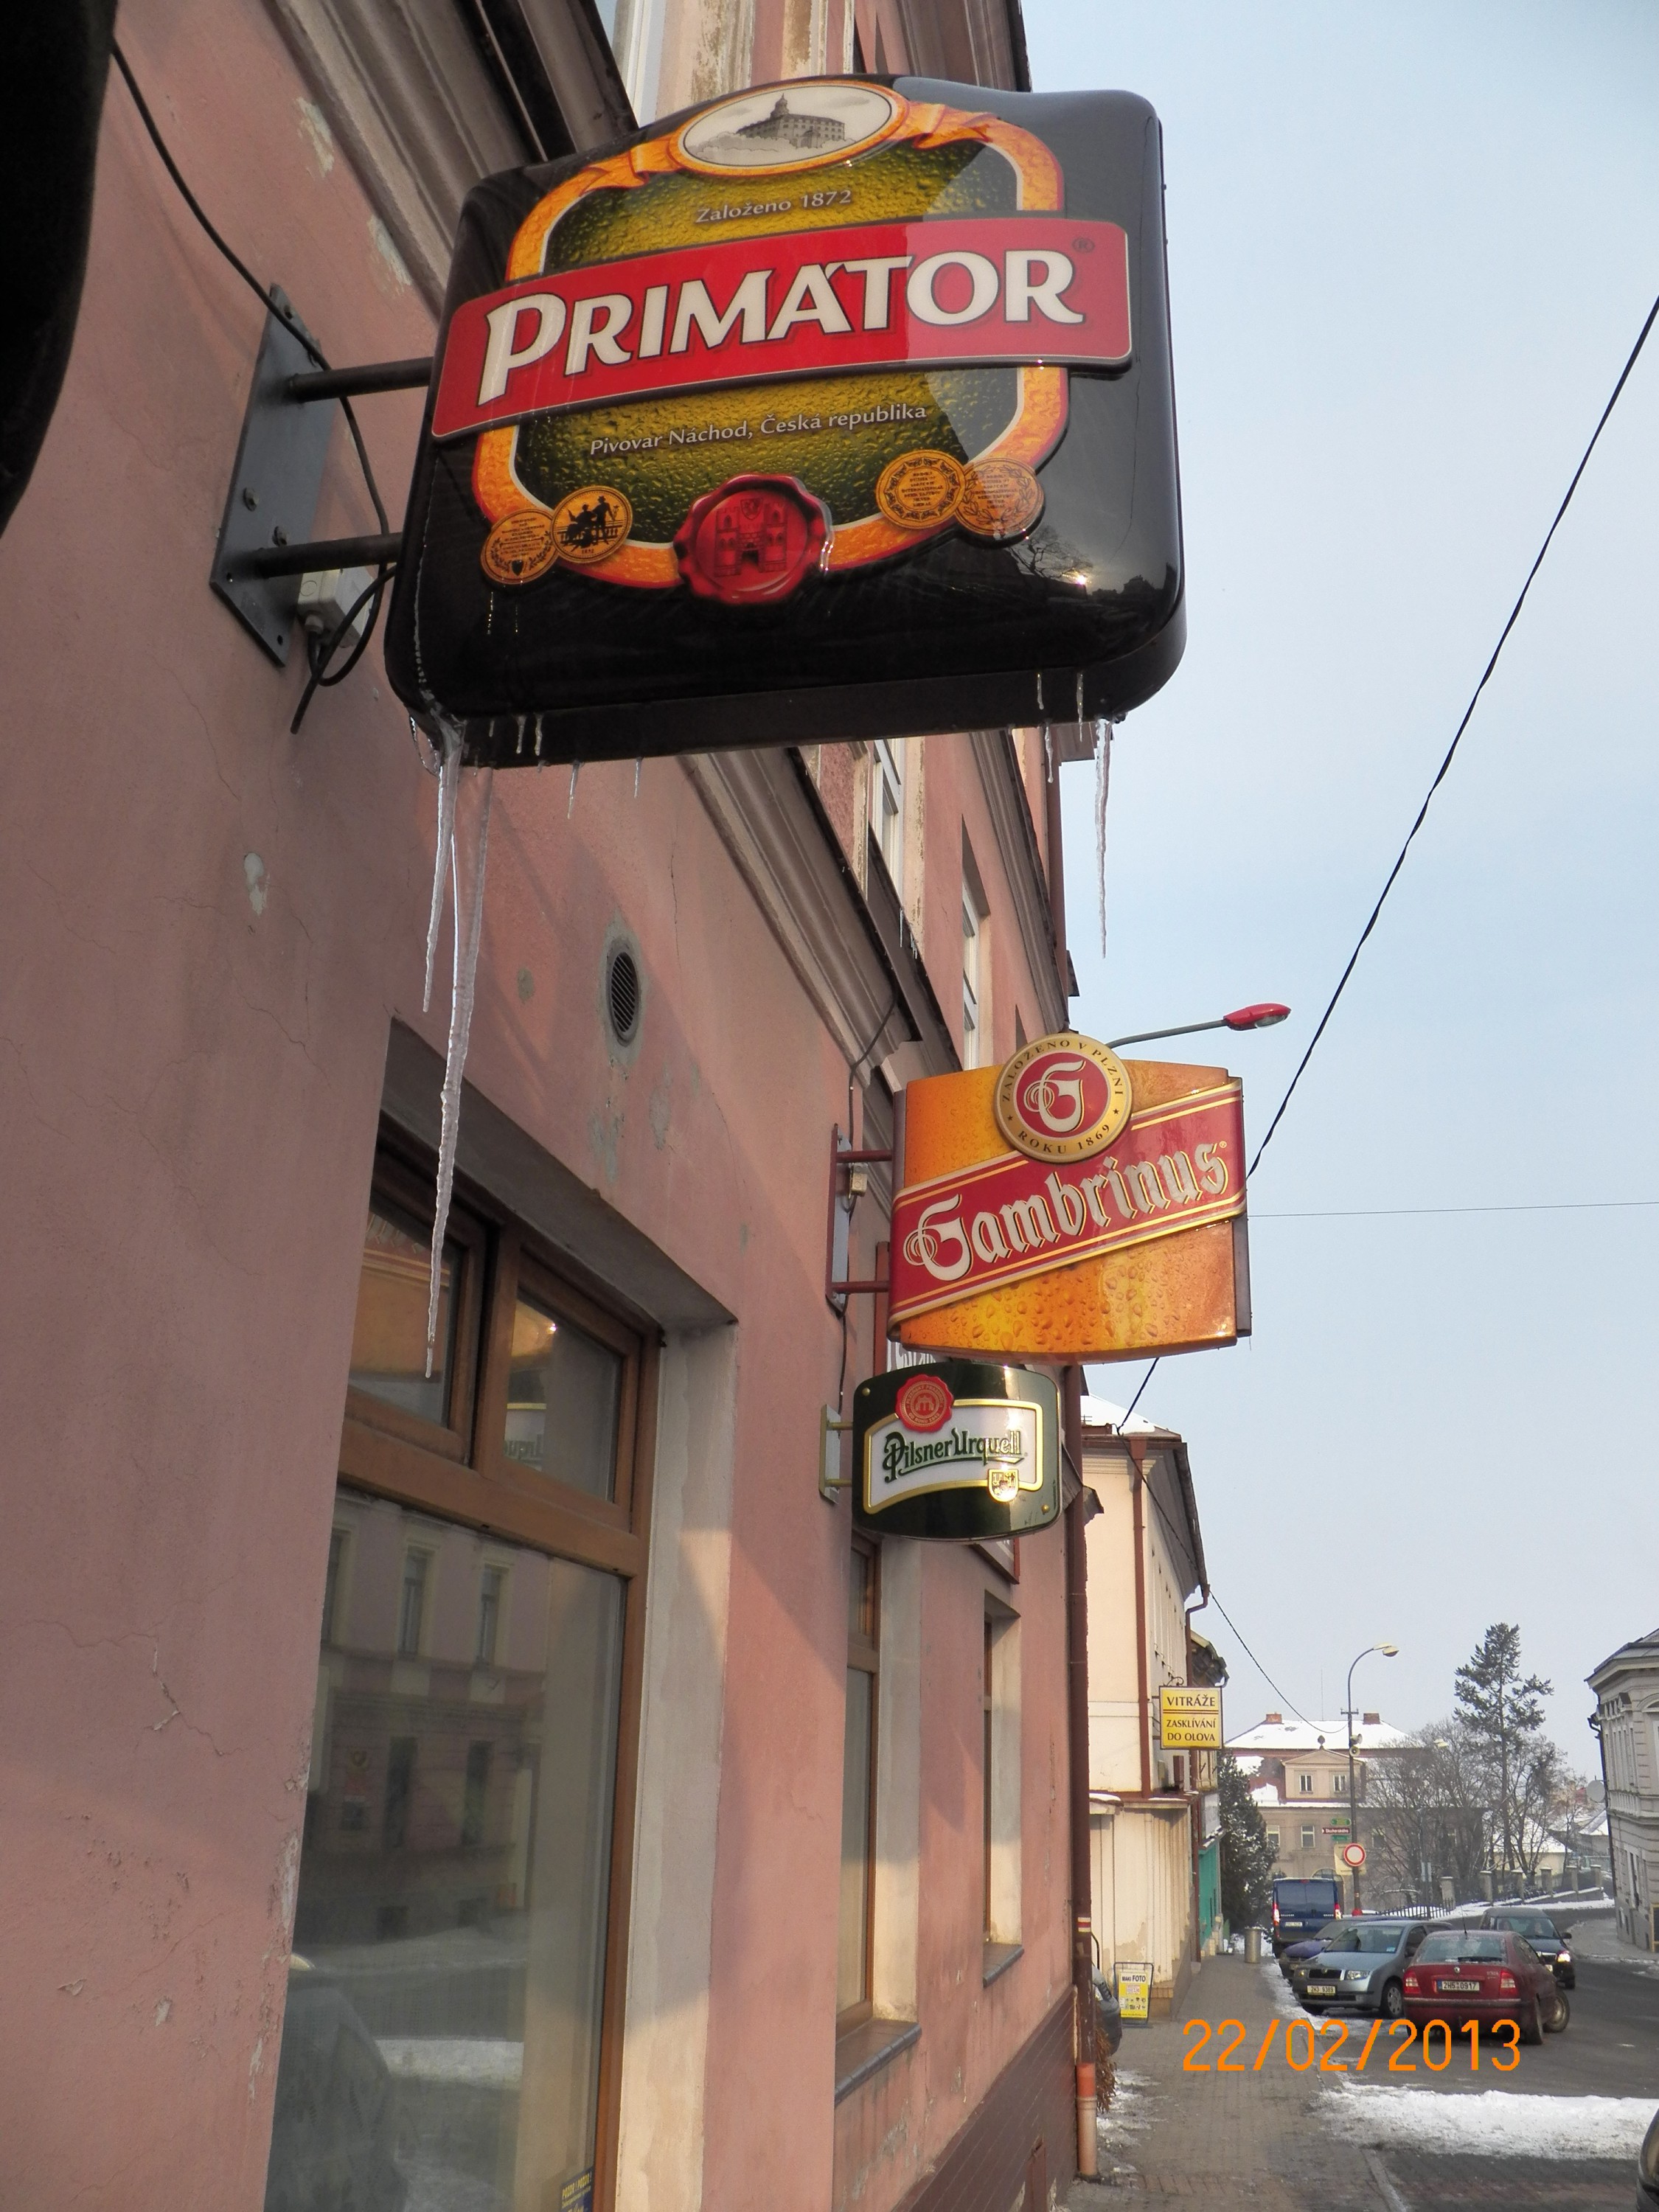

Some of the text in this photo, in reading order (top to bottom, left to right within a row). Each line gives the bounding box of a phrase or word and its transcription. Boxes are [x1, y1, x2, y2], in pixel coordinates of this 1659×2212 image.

[695, 189, 852, 223] Založeno 1872
[590, 403, 927, 455] Pivovar Náchod, Česká republika
[1092, 1049, 1124, 1094] PLZNI
[1018, 1124, 1110, 1154] ROKU 1869
[903, 1141, 1230, 1281] Gambrinus
[883, 1427, 1022, 1484] Pilsner Urquell
[1166, 1694, 1215, 1706] VITRÁŽE
[1166, 1718, 1216, 1728] ZASKLÍVÁNÍ
[1167, 1733, 1215, 1741] DO OLOVA
